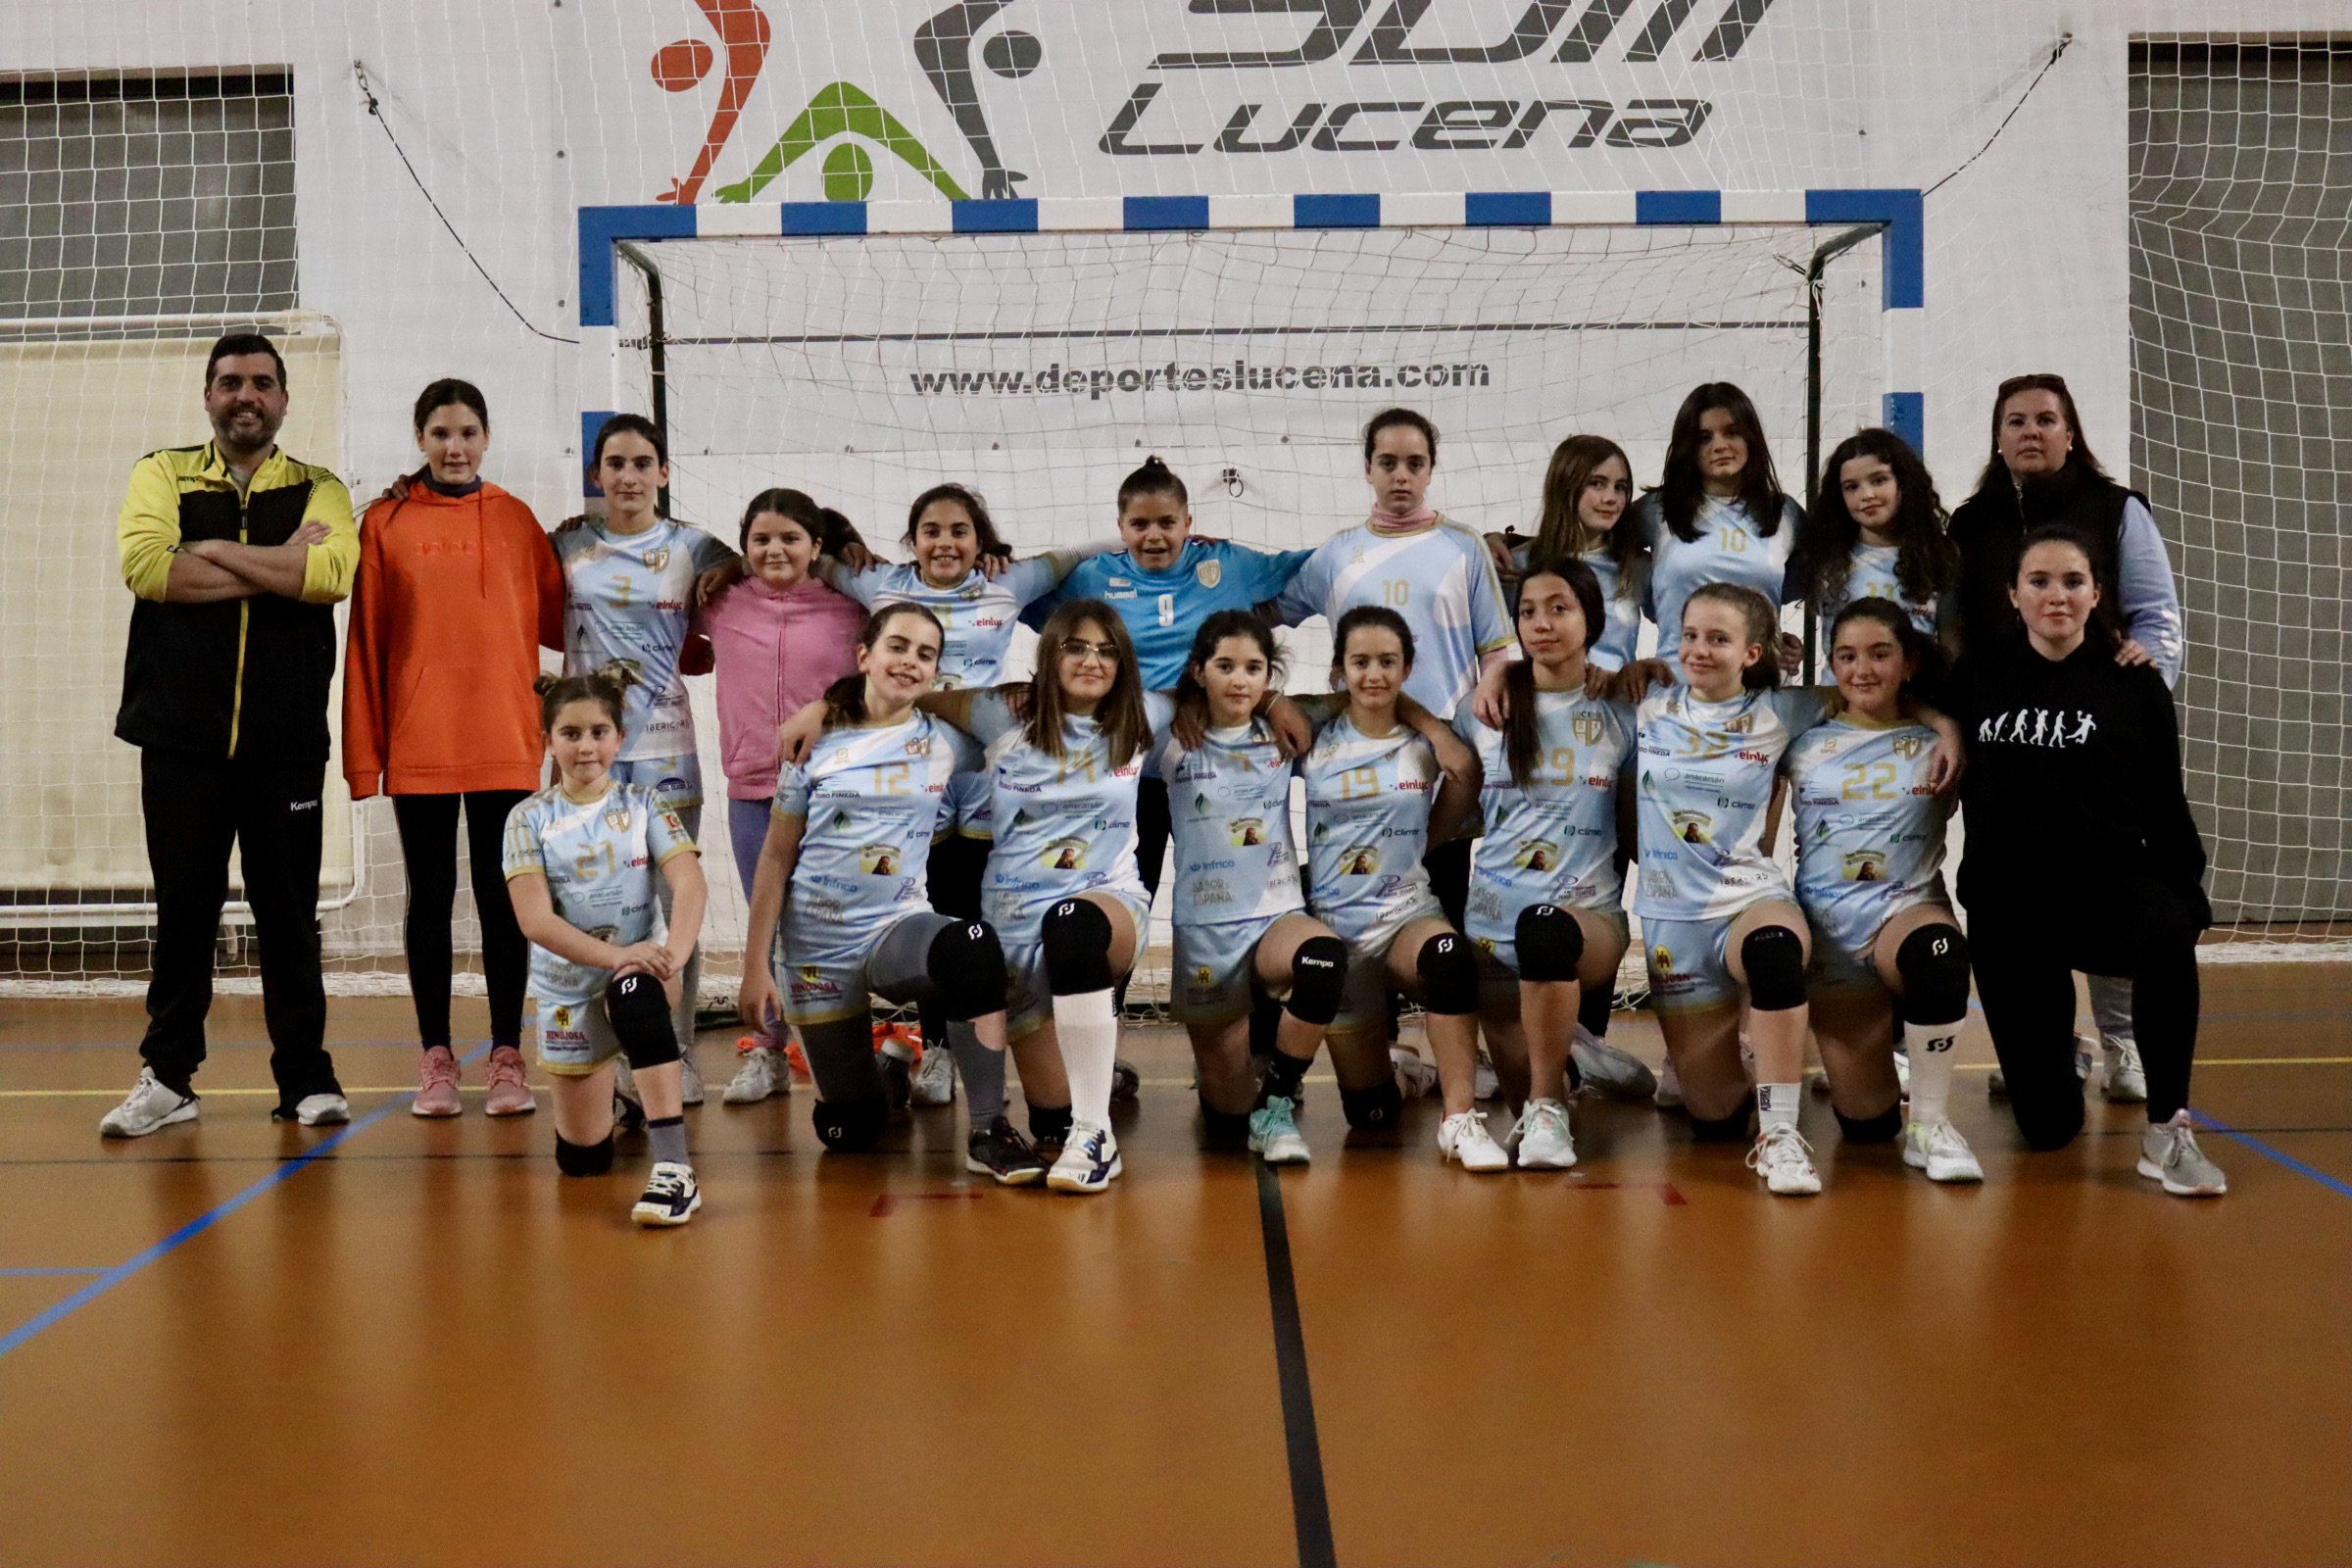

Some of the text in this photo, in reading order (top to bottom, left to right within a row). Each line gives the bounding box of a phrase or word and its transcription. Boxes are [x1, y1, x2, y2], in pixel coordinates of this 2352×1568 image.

[1099, 82, 1713, 155] Lucena
[909, 360, 1490, 400] www.deporteslucena.com
[1719, 527, 1746, 553] 10
[610, 575, 631, 609] 3
[1104, 588, 1138, 599] hummel
[1382, 579, 1409, 606] 10
[1158, 594, 1175, 627] 9
[873, 761, 912, 795] 12
[1342, 765, 1381, 801] 19
[1841, 762, 1897, 801] 22
[290, 799, 318, 811] Kempa
[576, 839, 616, 878] 21
[1301, 956, 1335, 968] Kempa
[546, 1030, 586, 1041] HINOJOSA
